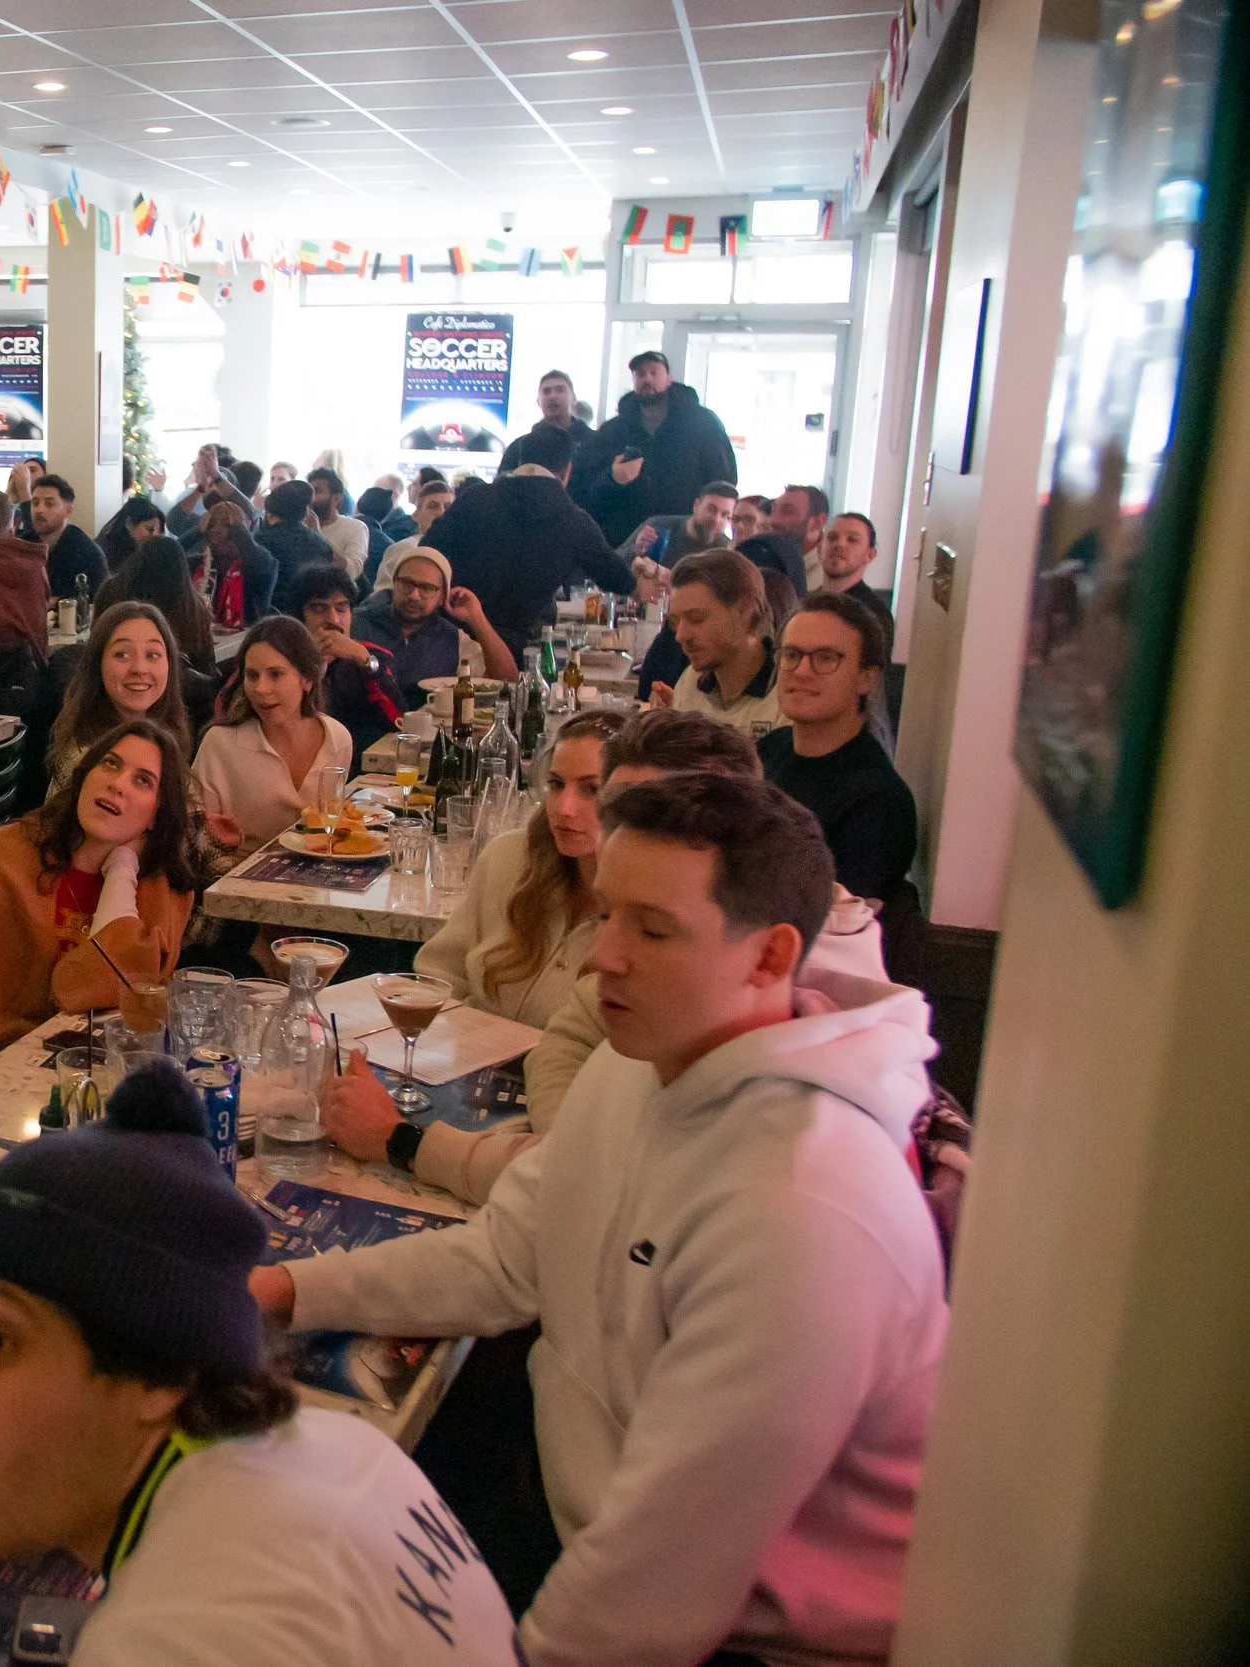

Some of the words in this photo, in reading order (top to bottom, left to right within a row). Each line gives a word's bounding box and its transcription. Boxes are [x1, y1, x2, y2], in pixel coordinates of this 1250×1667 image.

[408, 337, 507, 359] SOCCER
[406, 358, 508, 373] HEADQUARTERS
[217, 1111, 230, 1140] 3
